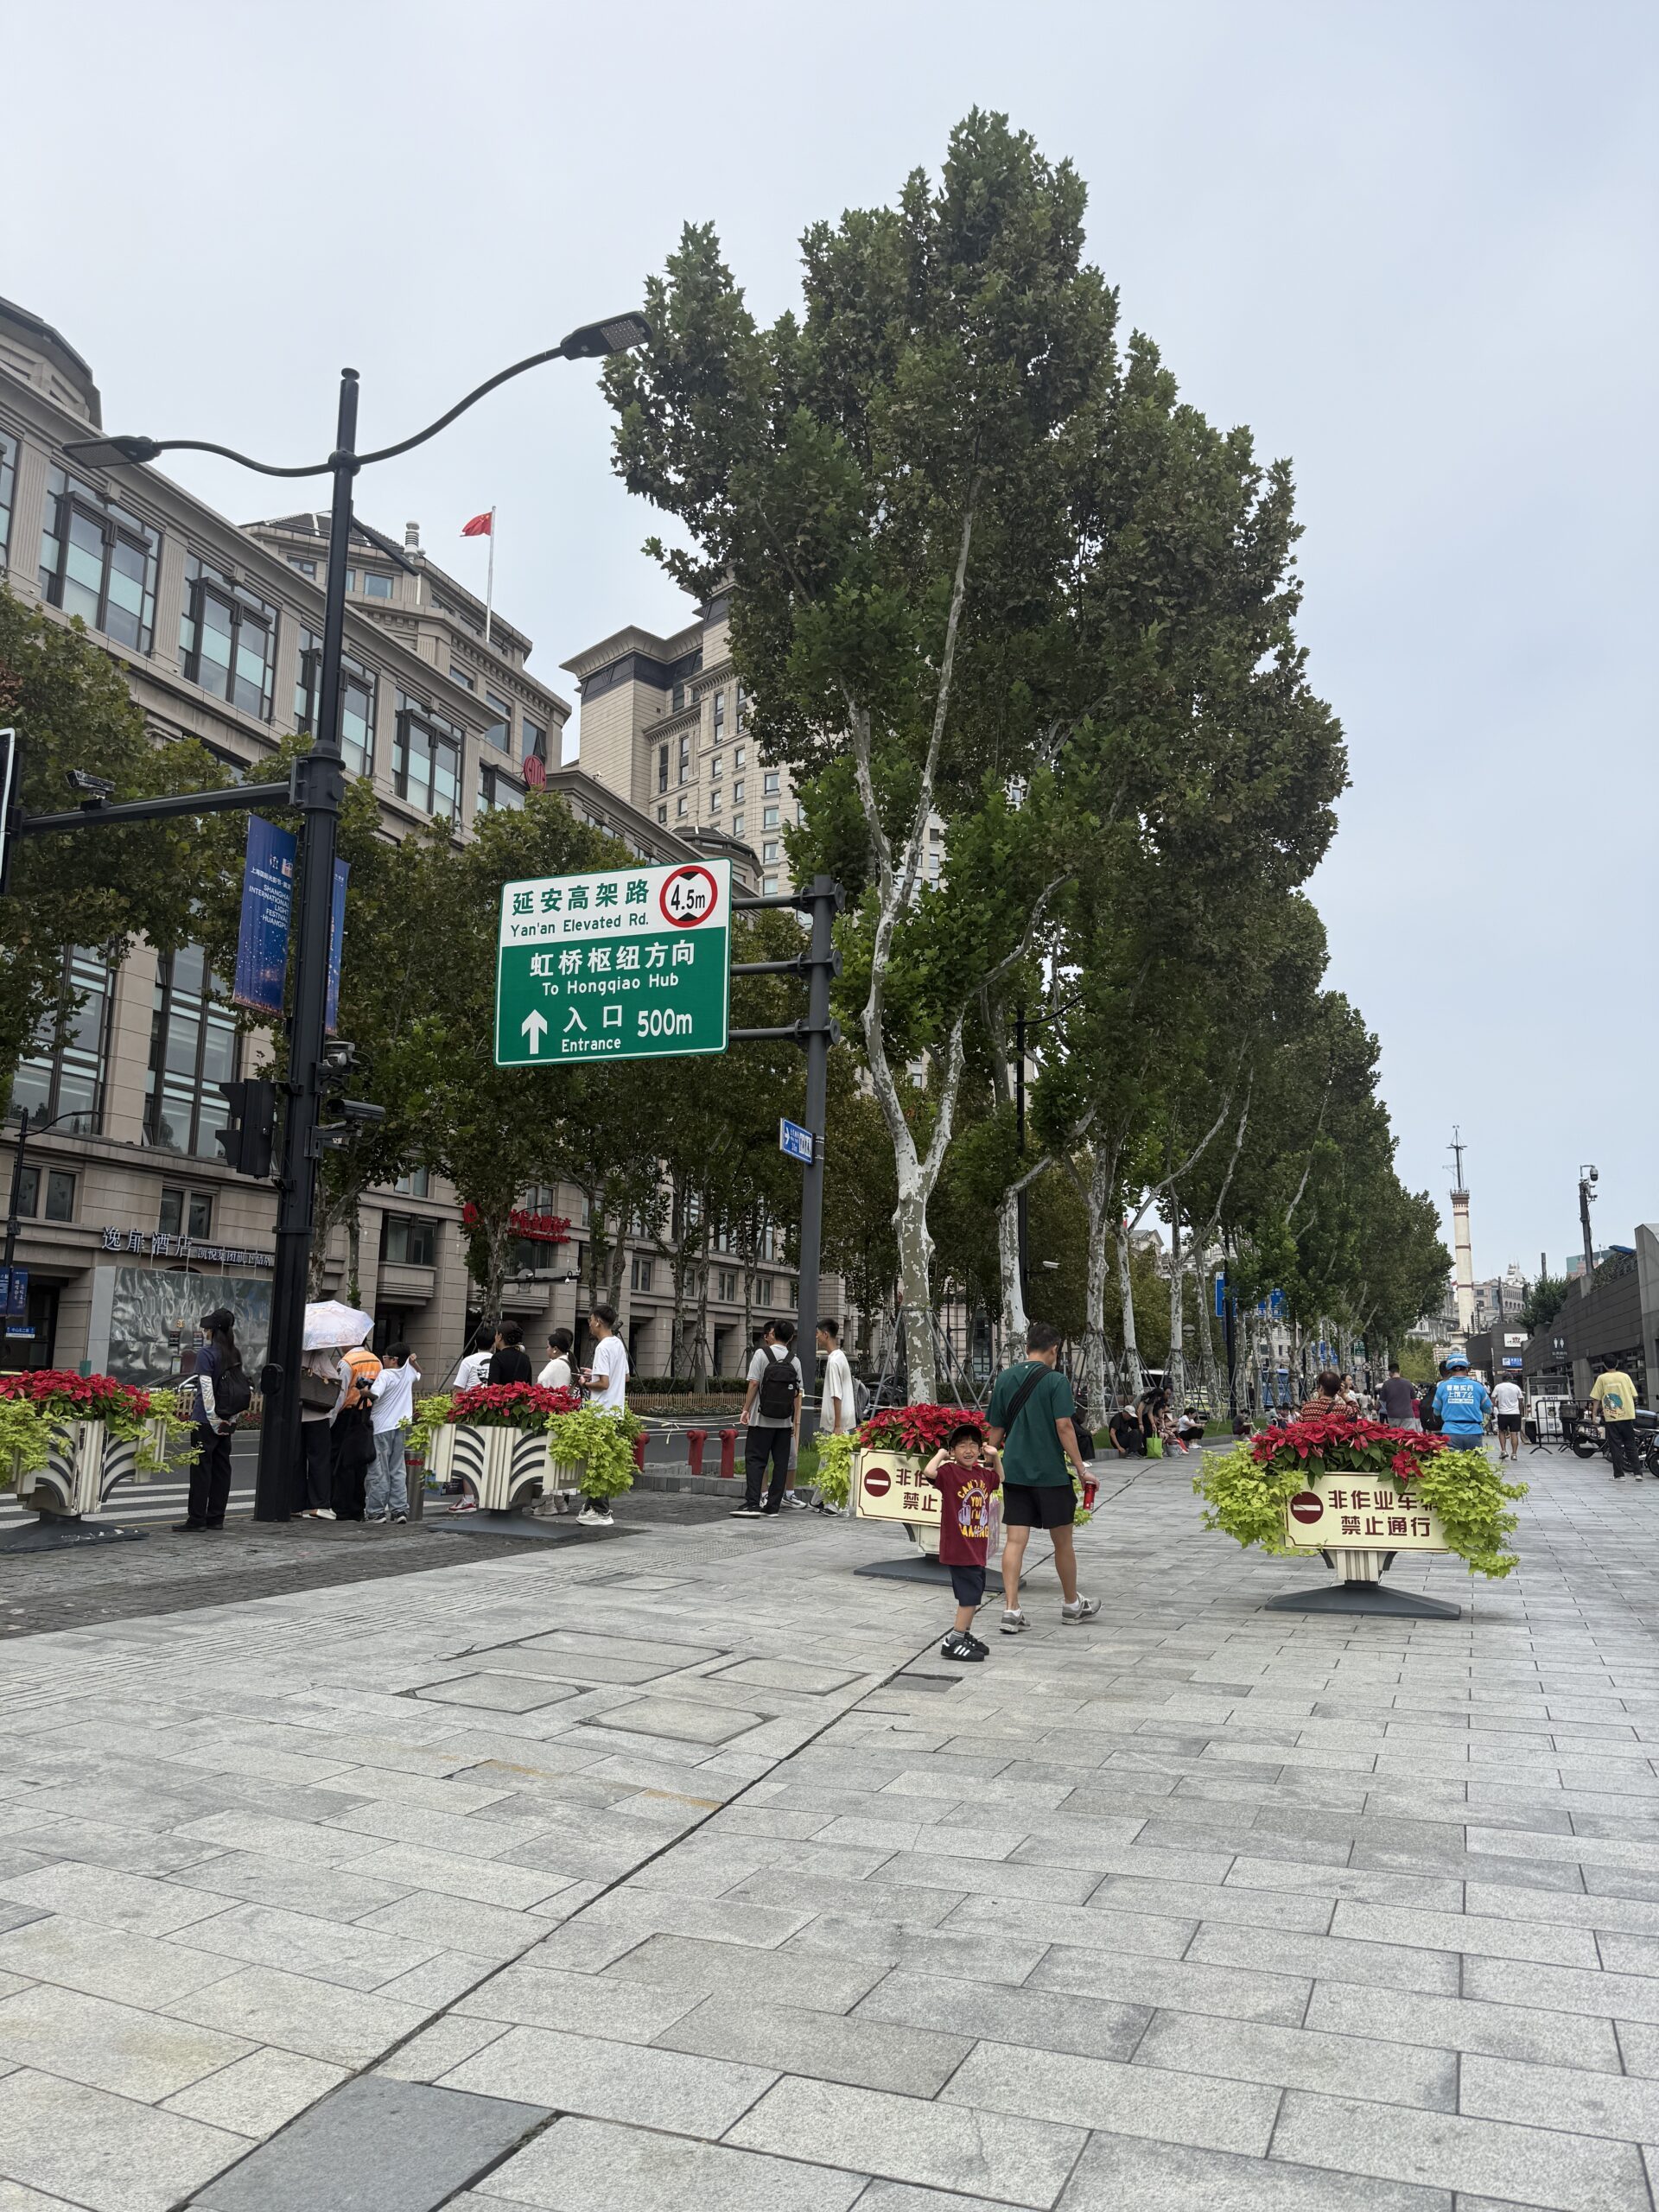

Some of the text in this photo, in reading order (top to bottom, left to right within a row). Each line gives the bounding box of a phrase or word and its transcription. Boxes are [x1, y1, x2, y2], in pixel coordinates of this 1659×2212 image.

[249, 886, 289, 908] INTERNATIONAL
[512, 879, 649, 917] 延安高架路
[671, 884, 706, 912] 4.5m
[511, 912, 649, 938] Yan'an Elevated Rd.
[530, 938, 695, 977] 虹桥枢纽方向
[543, 973, 678, 996] To Hongqiao Hub
[563, 1005, 692, 1037] 入口 500m
[562, 1037, 621, 1052] Entrance
[101, 1225, 193, 1258] 逸扉酒店
[970, 1496, 982, 1507] YOU
[1341, 1516, 1431, 1537] 禁止通行
